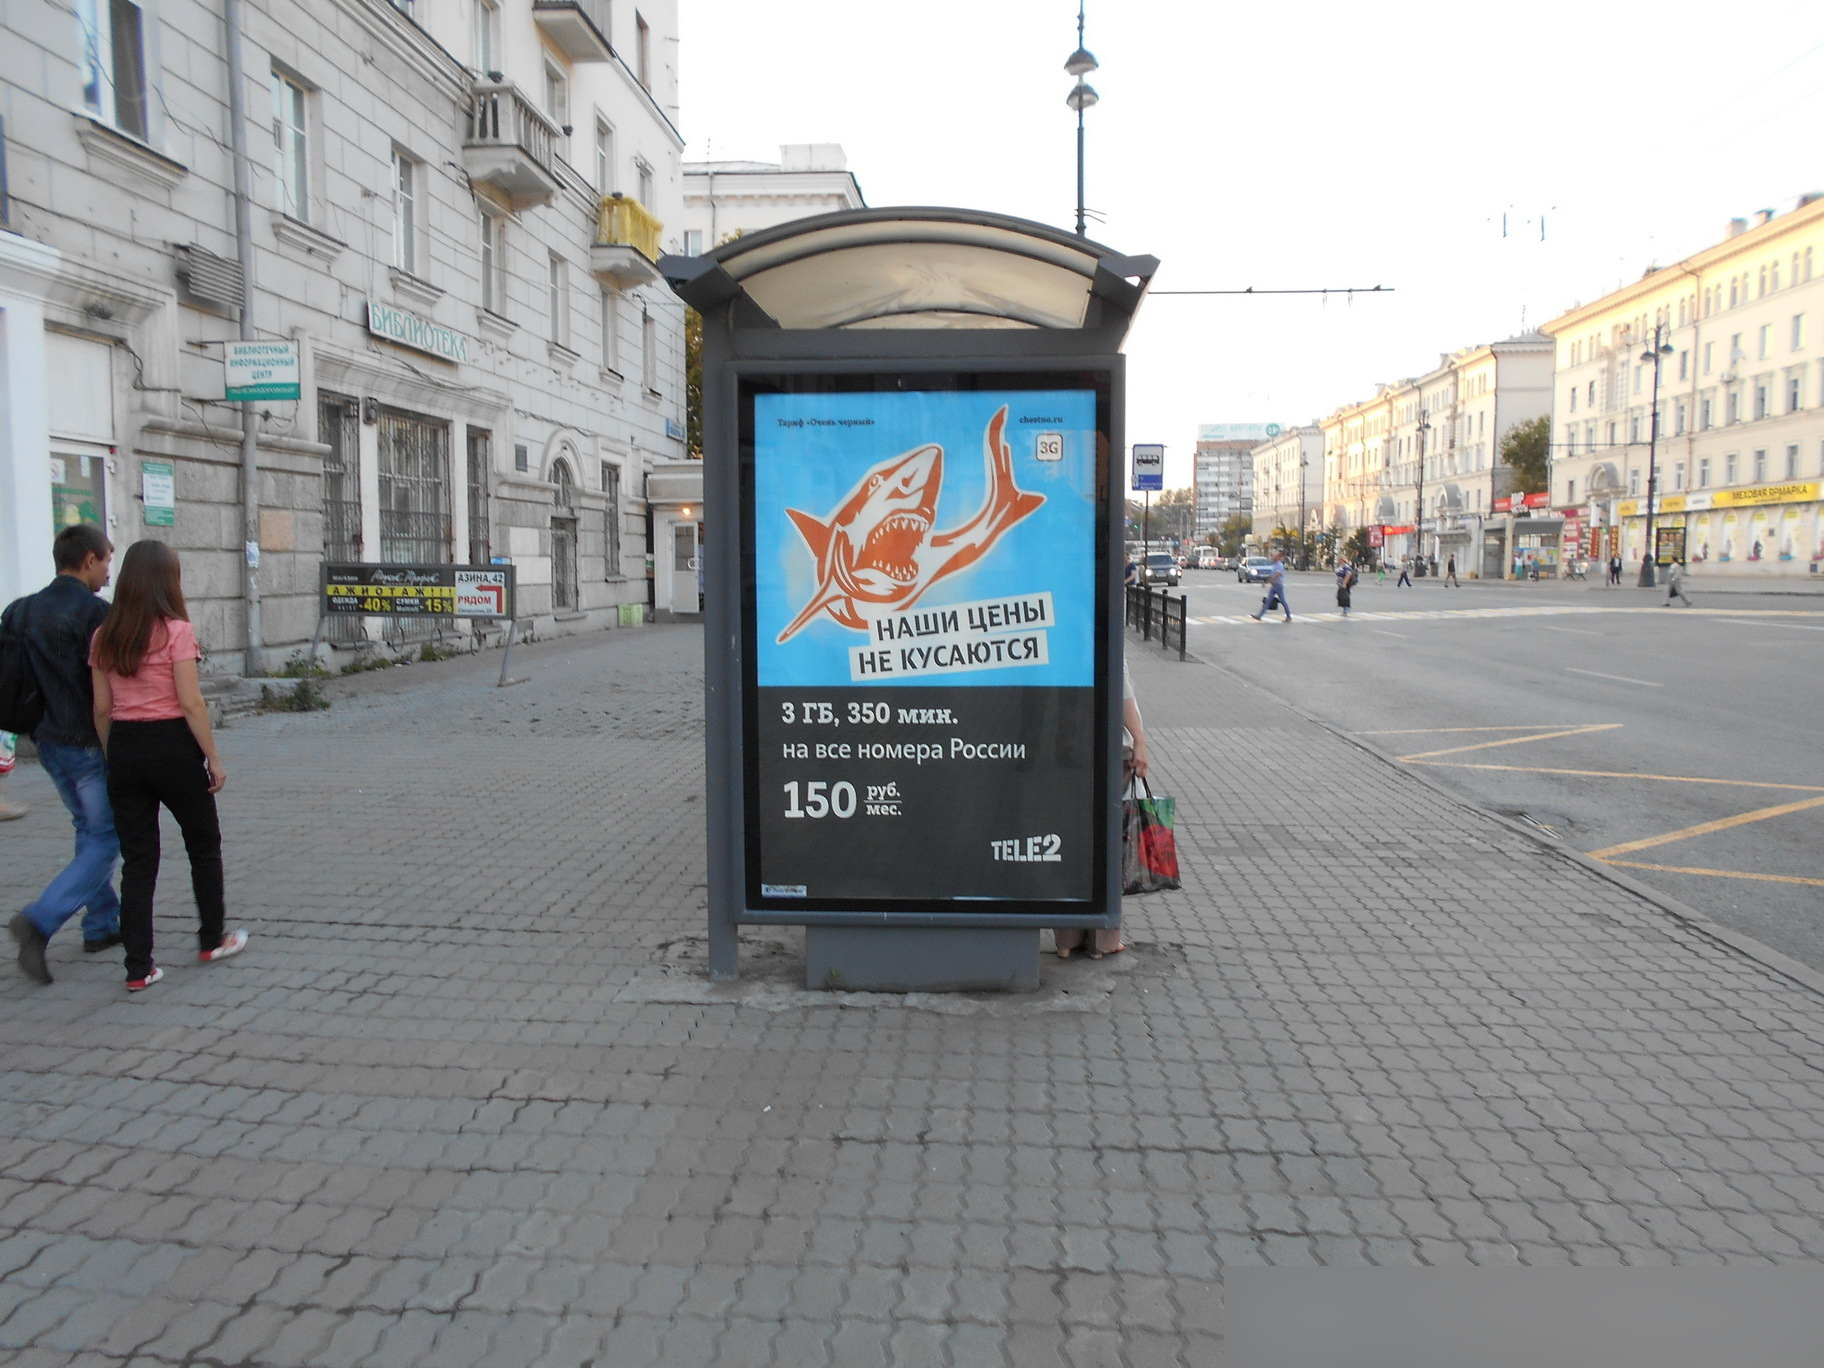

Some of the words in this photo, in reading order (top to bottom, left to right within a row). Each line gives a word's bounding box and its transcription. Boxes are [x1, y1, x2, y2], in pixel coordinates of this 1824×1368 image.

[370, 302, 467, 362] БИБЛИОТЕКА
[233, 344, 289, 355] БИБЛИОТЕЧНЫЙ
[229, 356, 295, 367] ИНФОРМАЦИОННЫЙ
[251, 370, 273, 380] ЦЕНТР
[777, 417, 804, 428] Тариф
[1019, 416, 1063, 424] chestno.ru
[1040, 441, 1058, 454] 3G
[1732, 487, 1767, 499] МЕХОВАЯ
[1769, 484, 1808, 496] ЯРМАРКА
[458, 573, 491, 584] АЗИНА,
[493, 573, 503, 583] 42
[332, 597, 359, 605] ОДЕЖДА
[359, 597, 392, 612] -40%
[458, 595, 492, 605] РЯДОМ
[876, 609, 960, 642] НАШИ
[967, 598, 1046, 633] ЦЕНЫ
[858, 650, 893, 674] НЕ
[901, 636, 1039, 671] КУСАЮТСЯ
[781, 702, 796, 724] 3
[802, 702, 840, 728] ГБ,
[847, 701, 891, 724] 350
[898, 707, 959, 725] мин.
[782, 742, 809, 759] на
[815, 742, 851, 759] все
[857, 742, 943, 765] номера
[950, 737, 1026, 760] России
[783, 780, 857, 819] 150
[866, 782, 901, 801] руб.
[866, 803, 902, 816] мес.
[990, 833, 1062, 862] TELE2
